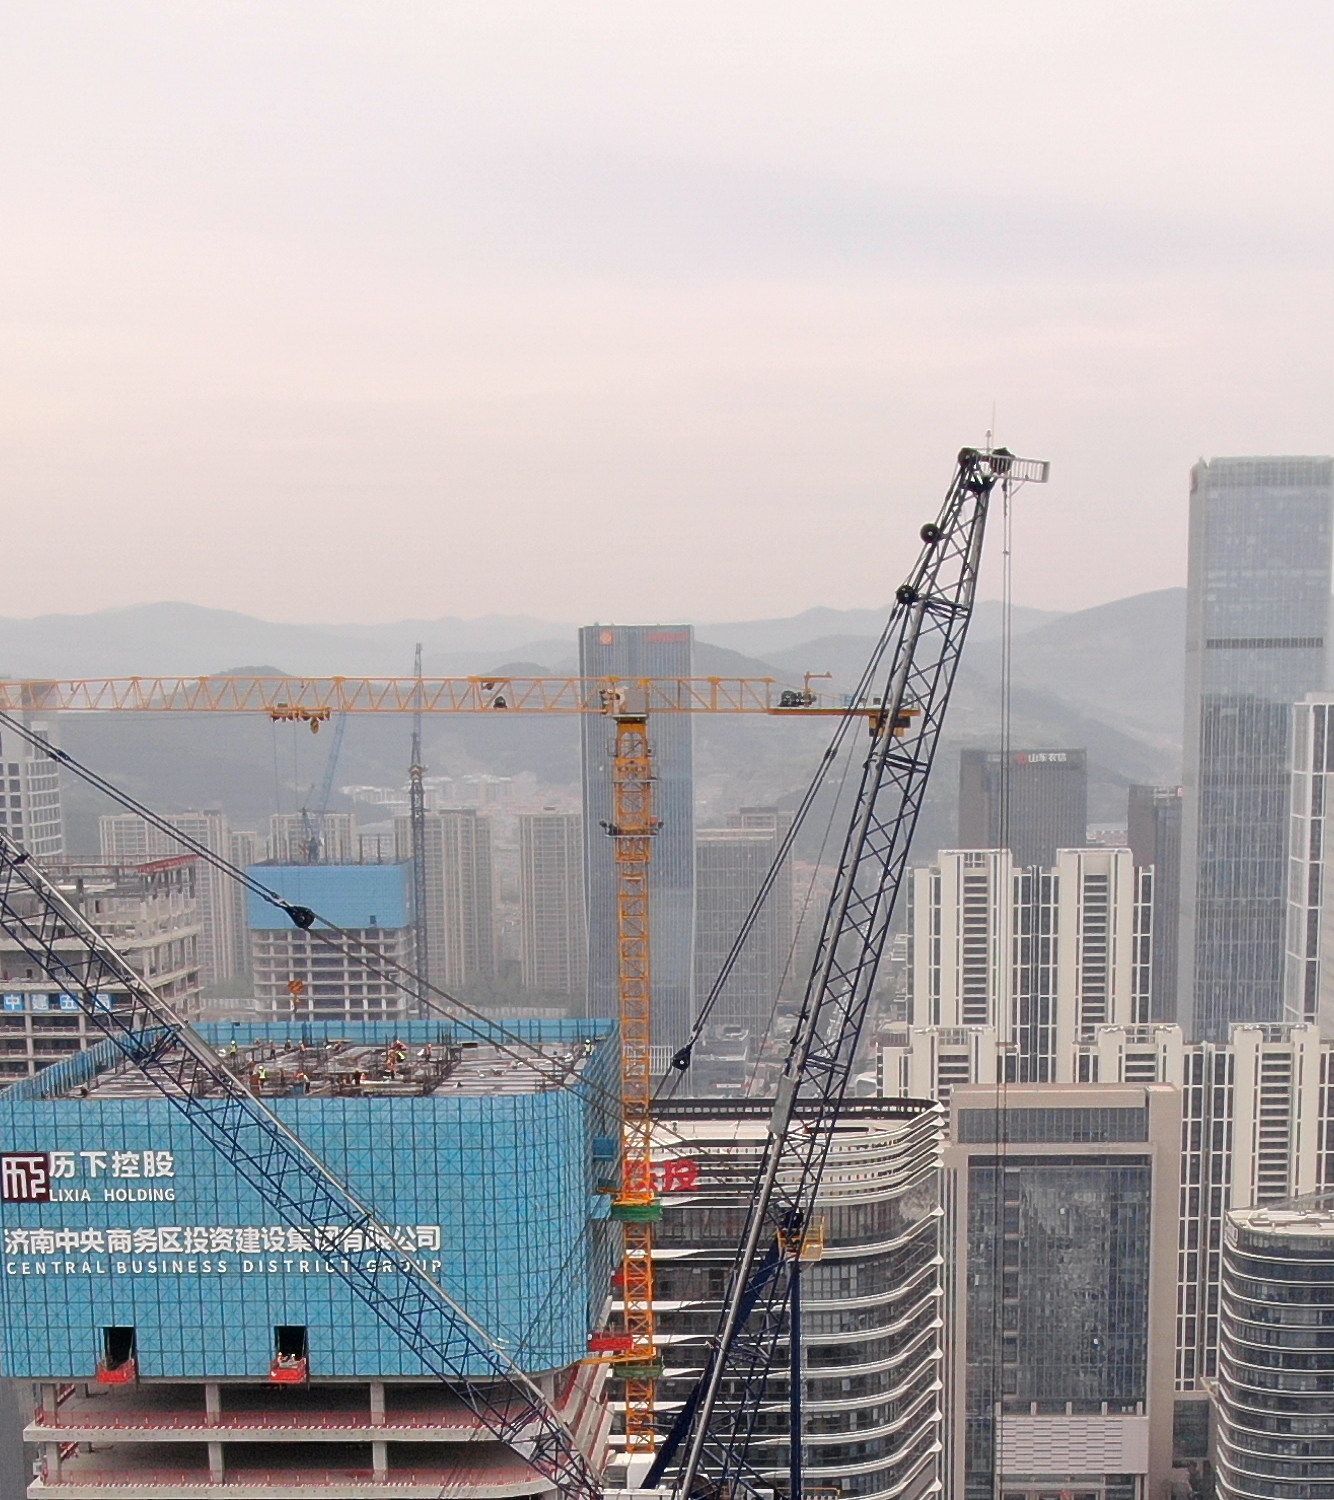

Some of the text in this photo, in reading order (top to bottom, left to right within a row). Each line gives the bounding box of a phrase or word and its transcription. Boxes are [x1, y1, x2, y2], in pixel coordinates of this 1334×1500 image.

[48, 1150, 175, 1179] 历下控股
[49, 1188, 176, 1202] LIXIA HOLDING
[4, 1226, 441, 1255] 济南中央商务区投资建设集团有限公司
[6, 1260, 106, 1275] CENTRAL
[116, 1260, 227, 1274] BUSINESS
[243, 1260, 351, 1274] DISTRICT
